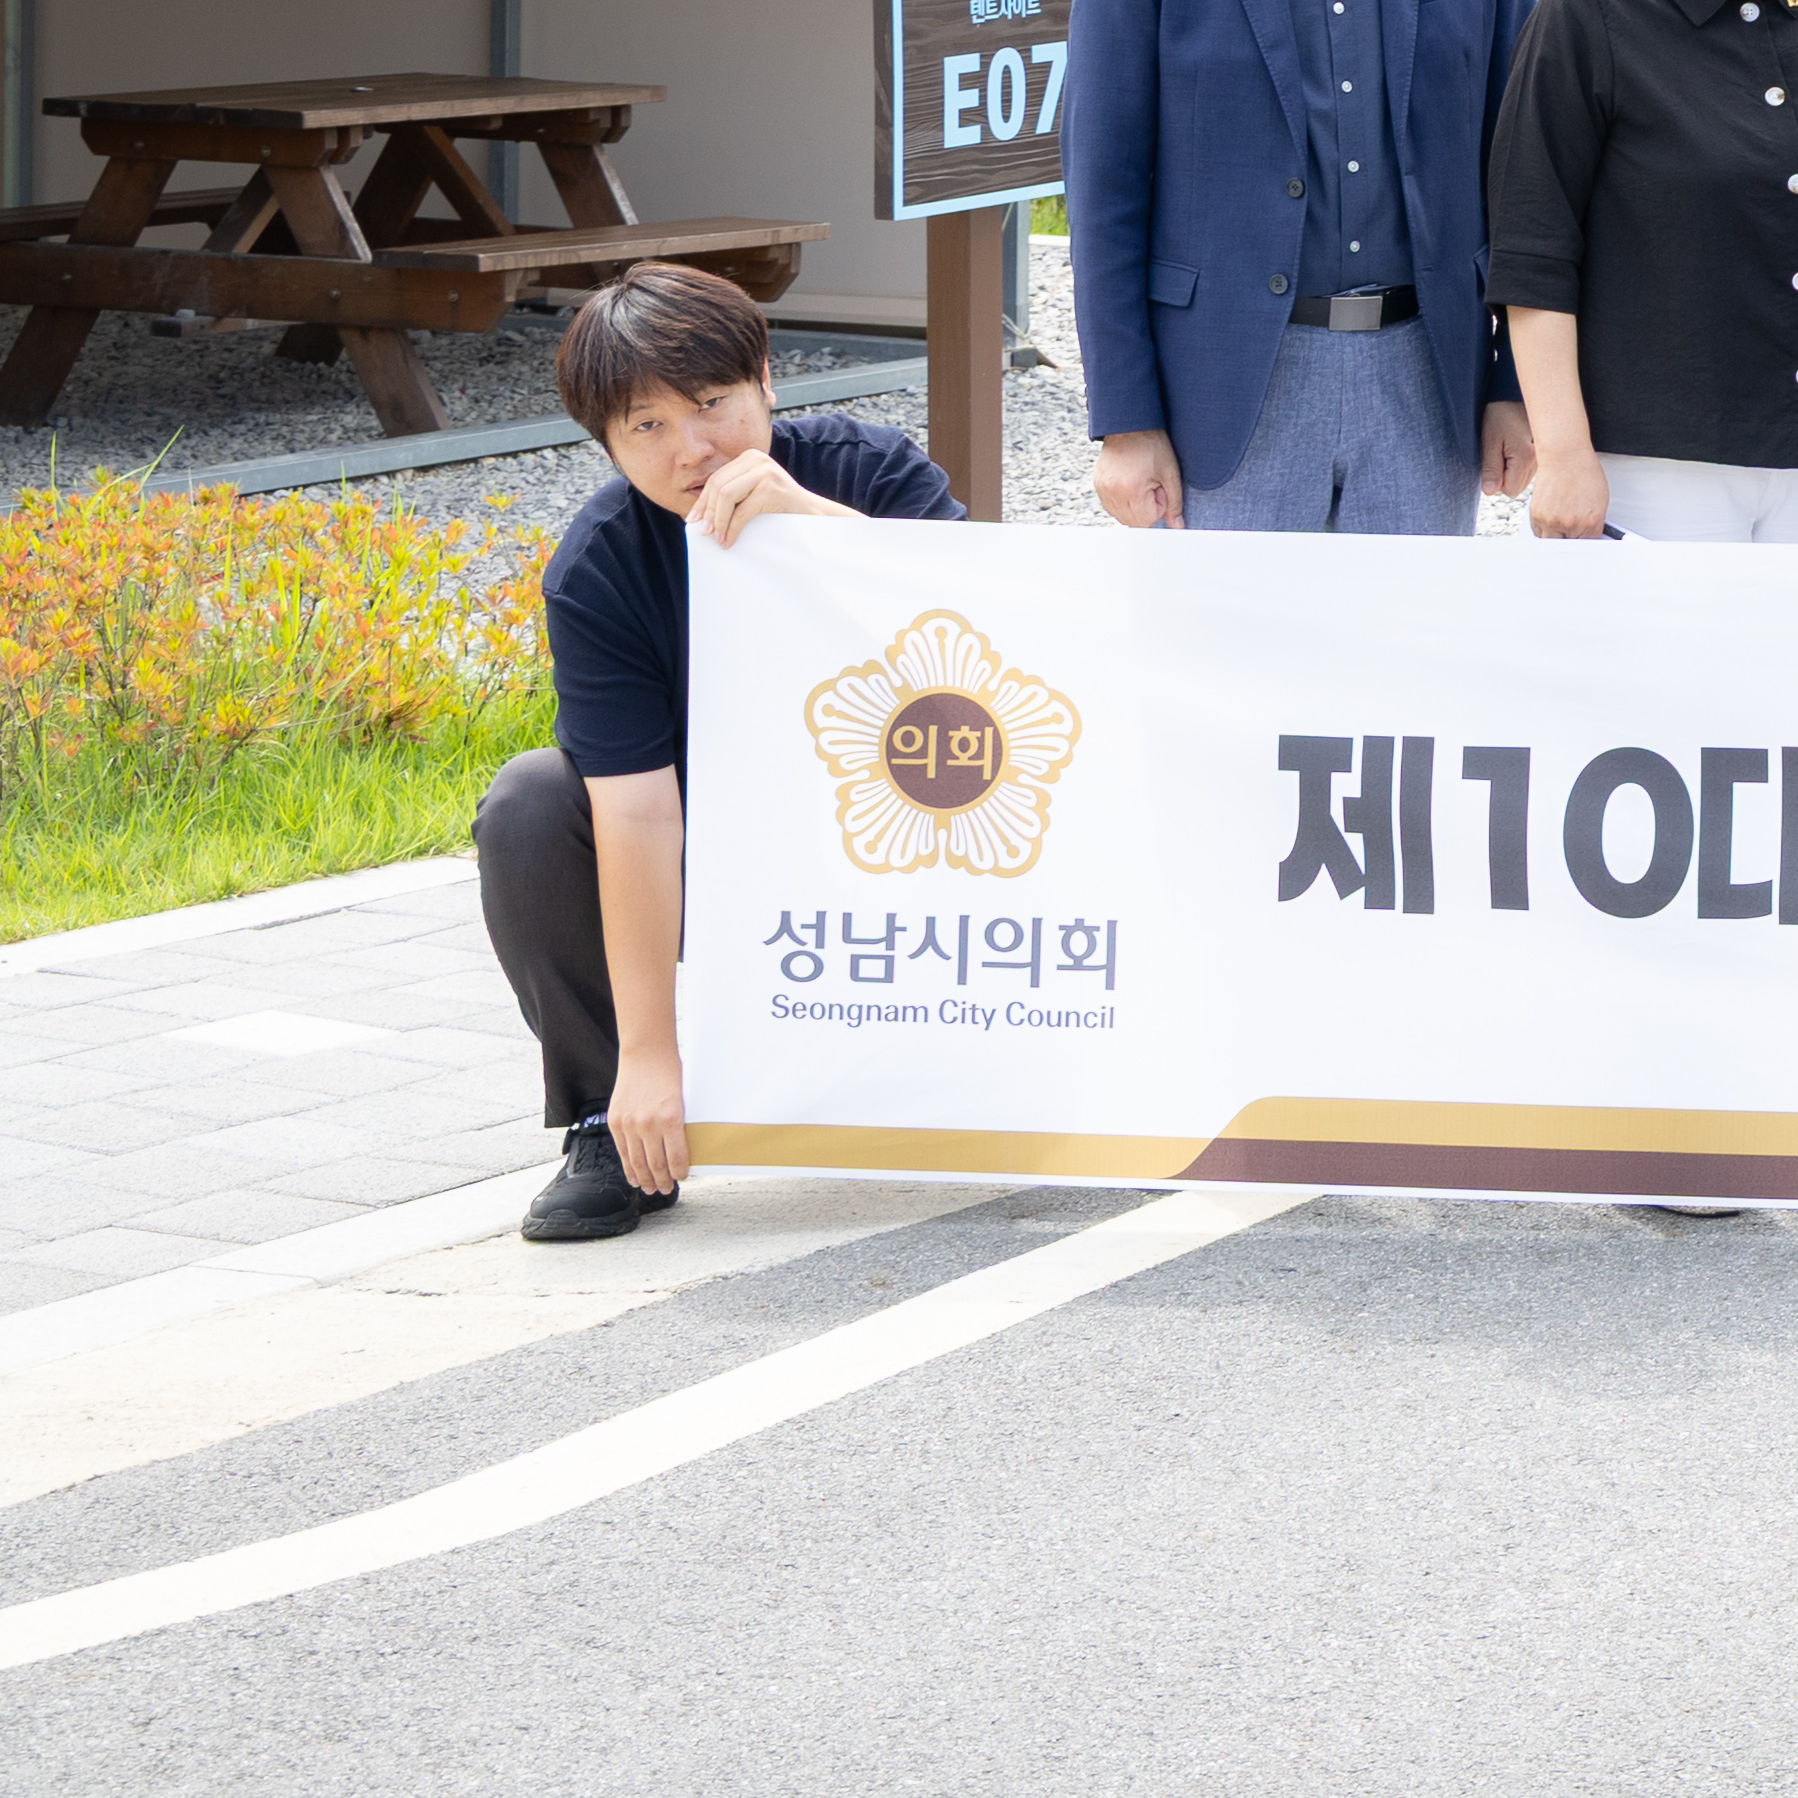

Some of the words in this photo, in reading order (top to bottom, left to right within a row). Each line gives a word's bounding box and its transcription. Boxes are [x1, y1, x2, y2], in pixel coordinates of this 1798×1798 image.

[943, 40, 1068, 149] E07
[890, 724, 995, 781] 의회
[762, 910, 1119, 991] 성남시의회
[771, 994, 930, 1029] Seongnam
[938, 998, 997, 1032] City
[1004, 1001, 1116, 1030] Council
